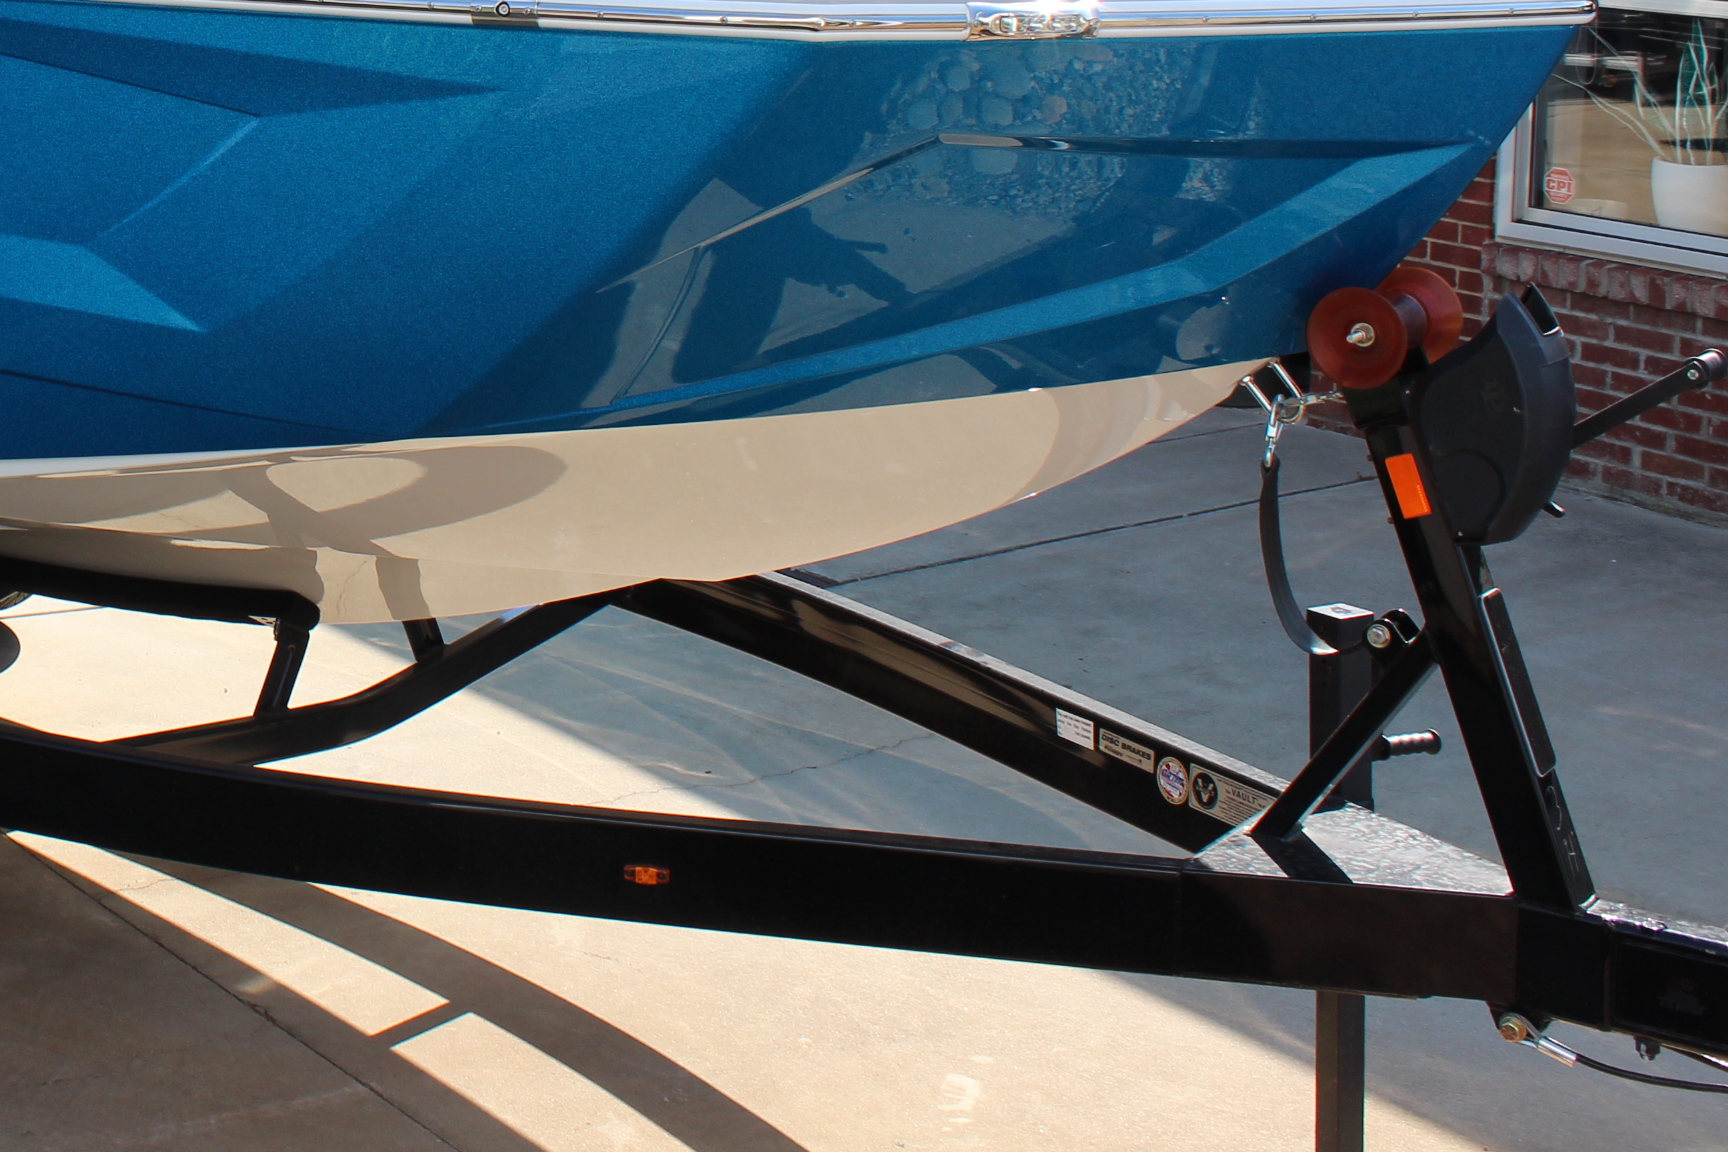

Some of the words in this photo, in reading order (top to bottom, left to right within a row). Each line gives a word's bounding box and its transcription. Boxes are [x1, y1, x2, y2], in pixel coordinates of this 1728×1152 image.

[1545, 177, 1574, 195] CPI
[1101, 733, 1120, 747] DISC
[1121, 741, 1152, 761] BRAKES
[1231, 787, 1257, 805] VAULT
